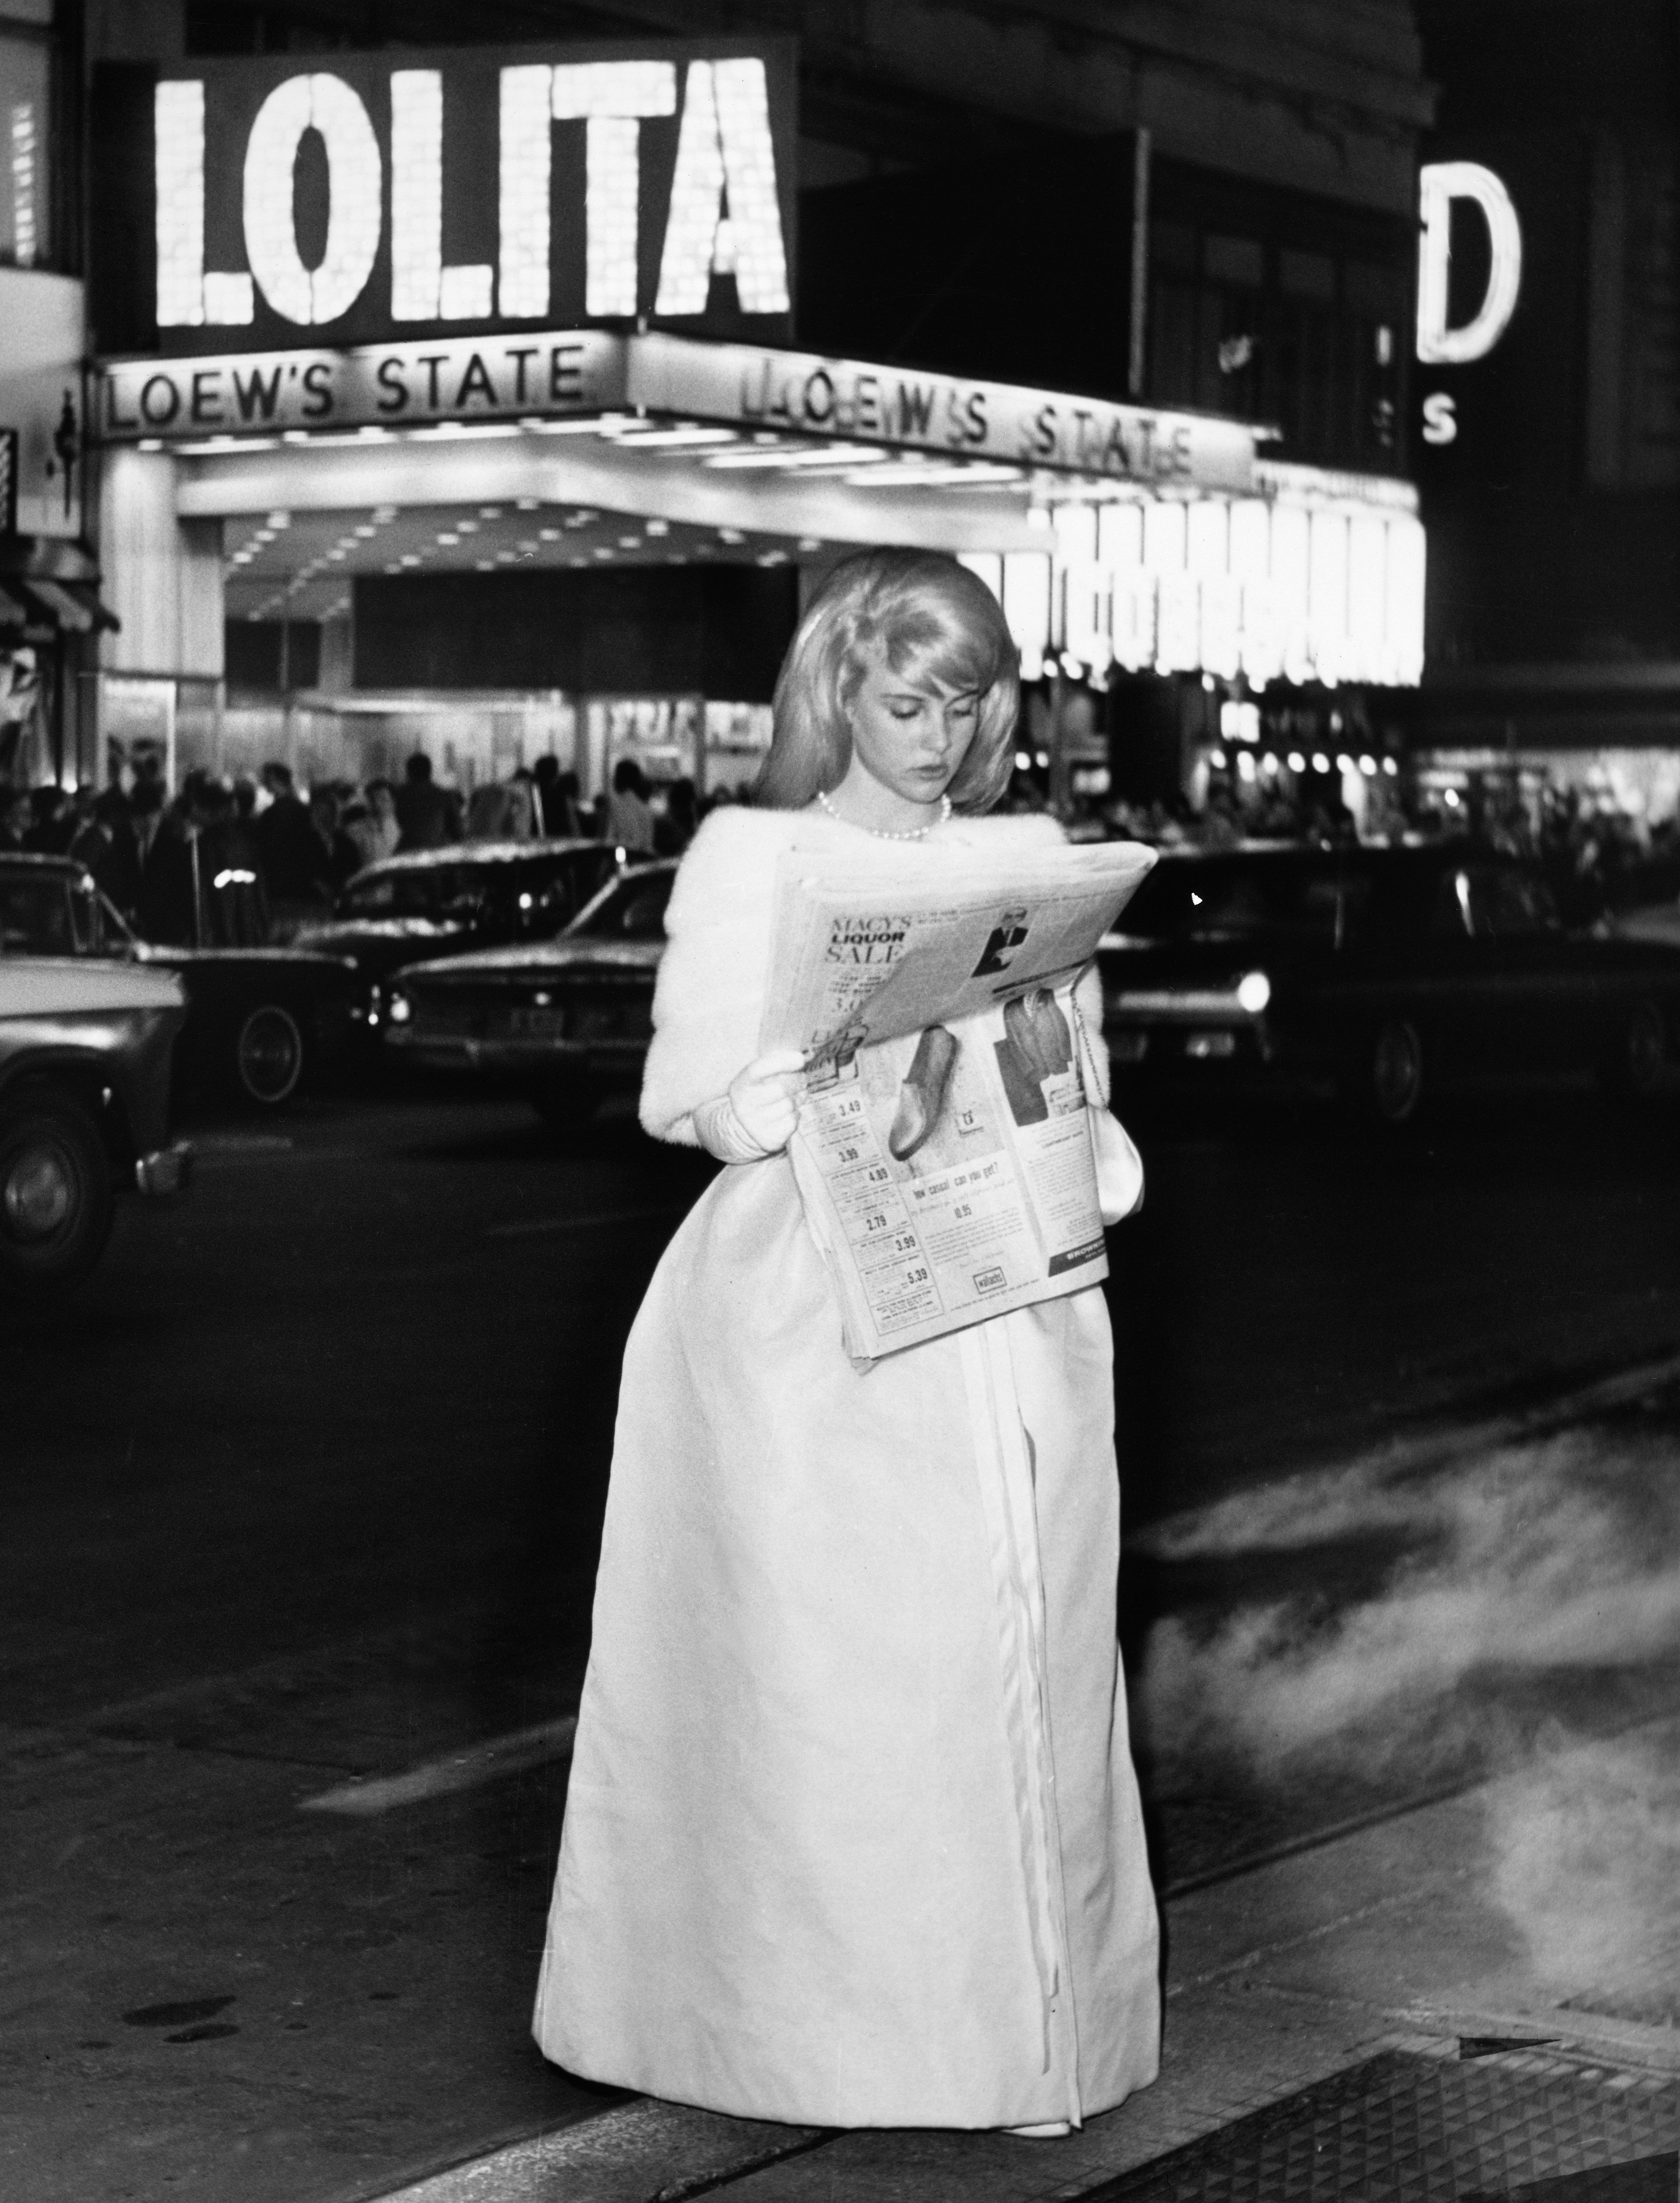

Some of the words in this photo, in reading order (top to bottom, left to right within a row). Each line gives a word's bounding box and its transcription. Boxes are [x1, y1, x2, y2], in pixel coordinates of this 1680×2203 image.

[155, 56, 791, 327] LOLITA
[1416, 161, 1522, 364] D
[106, 364, 333, 429] LOEW'S
[377, 345, 587, 411] STATE
[1026, 404, 1191, 476] STATE
[1422, 391, 1457, 445] S
[831, 932, 905, 945] LIQUOR
[866, 1215, 887, 1231] 2.79
[895, 1235, 916, 1251] 3.99
[907, 1268, 928, 1284] 5.39
